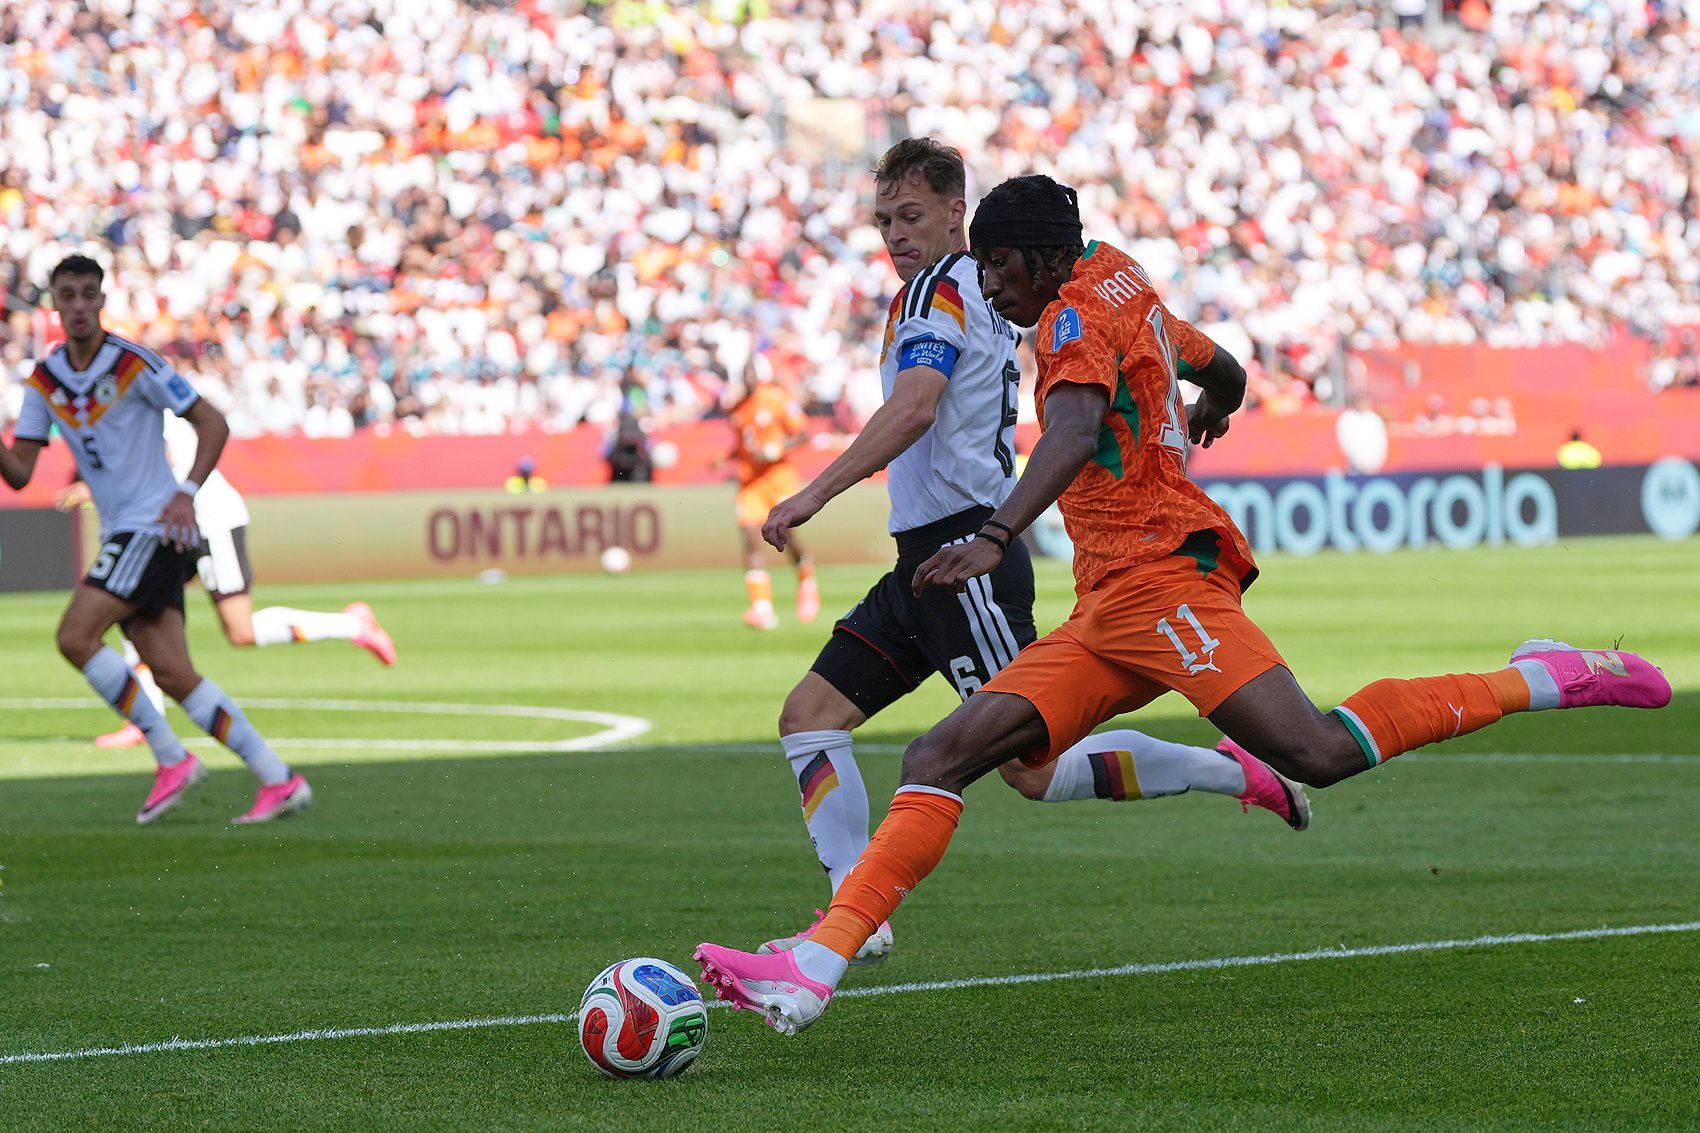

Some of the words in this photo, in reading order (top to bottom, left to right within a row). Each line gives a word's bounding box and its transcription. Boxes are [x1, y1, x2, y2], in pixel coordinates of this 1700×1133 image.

[1093, 271, 1143, 307] YAN
[912, 342, 946, 354] UNITES
[1147, 304, 1188, 474] 1
[83, 436, 104, 469] 5
[427, 503, 660, 560] ONTARIO
[1204, 461, 1559, 555] motorola
[1156, 603, 1220, 669] 11
[950, 655, 982, 702] 6
